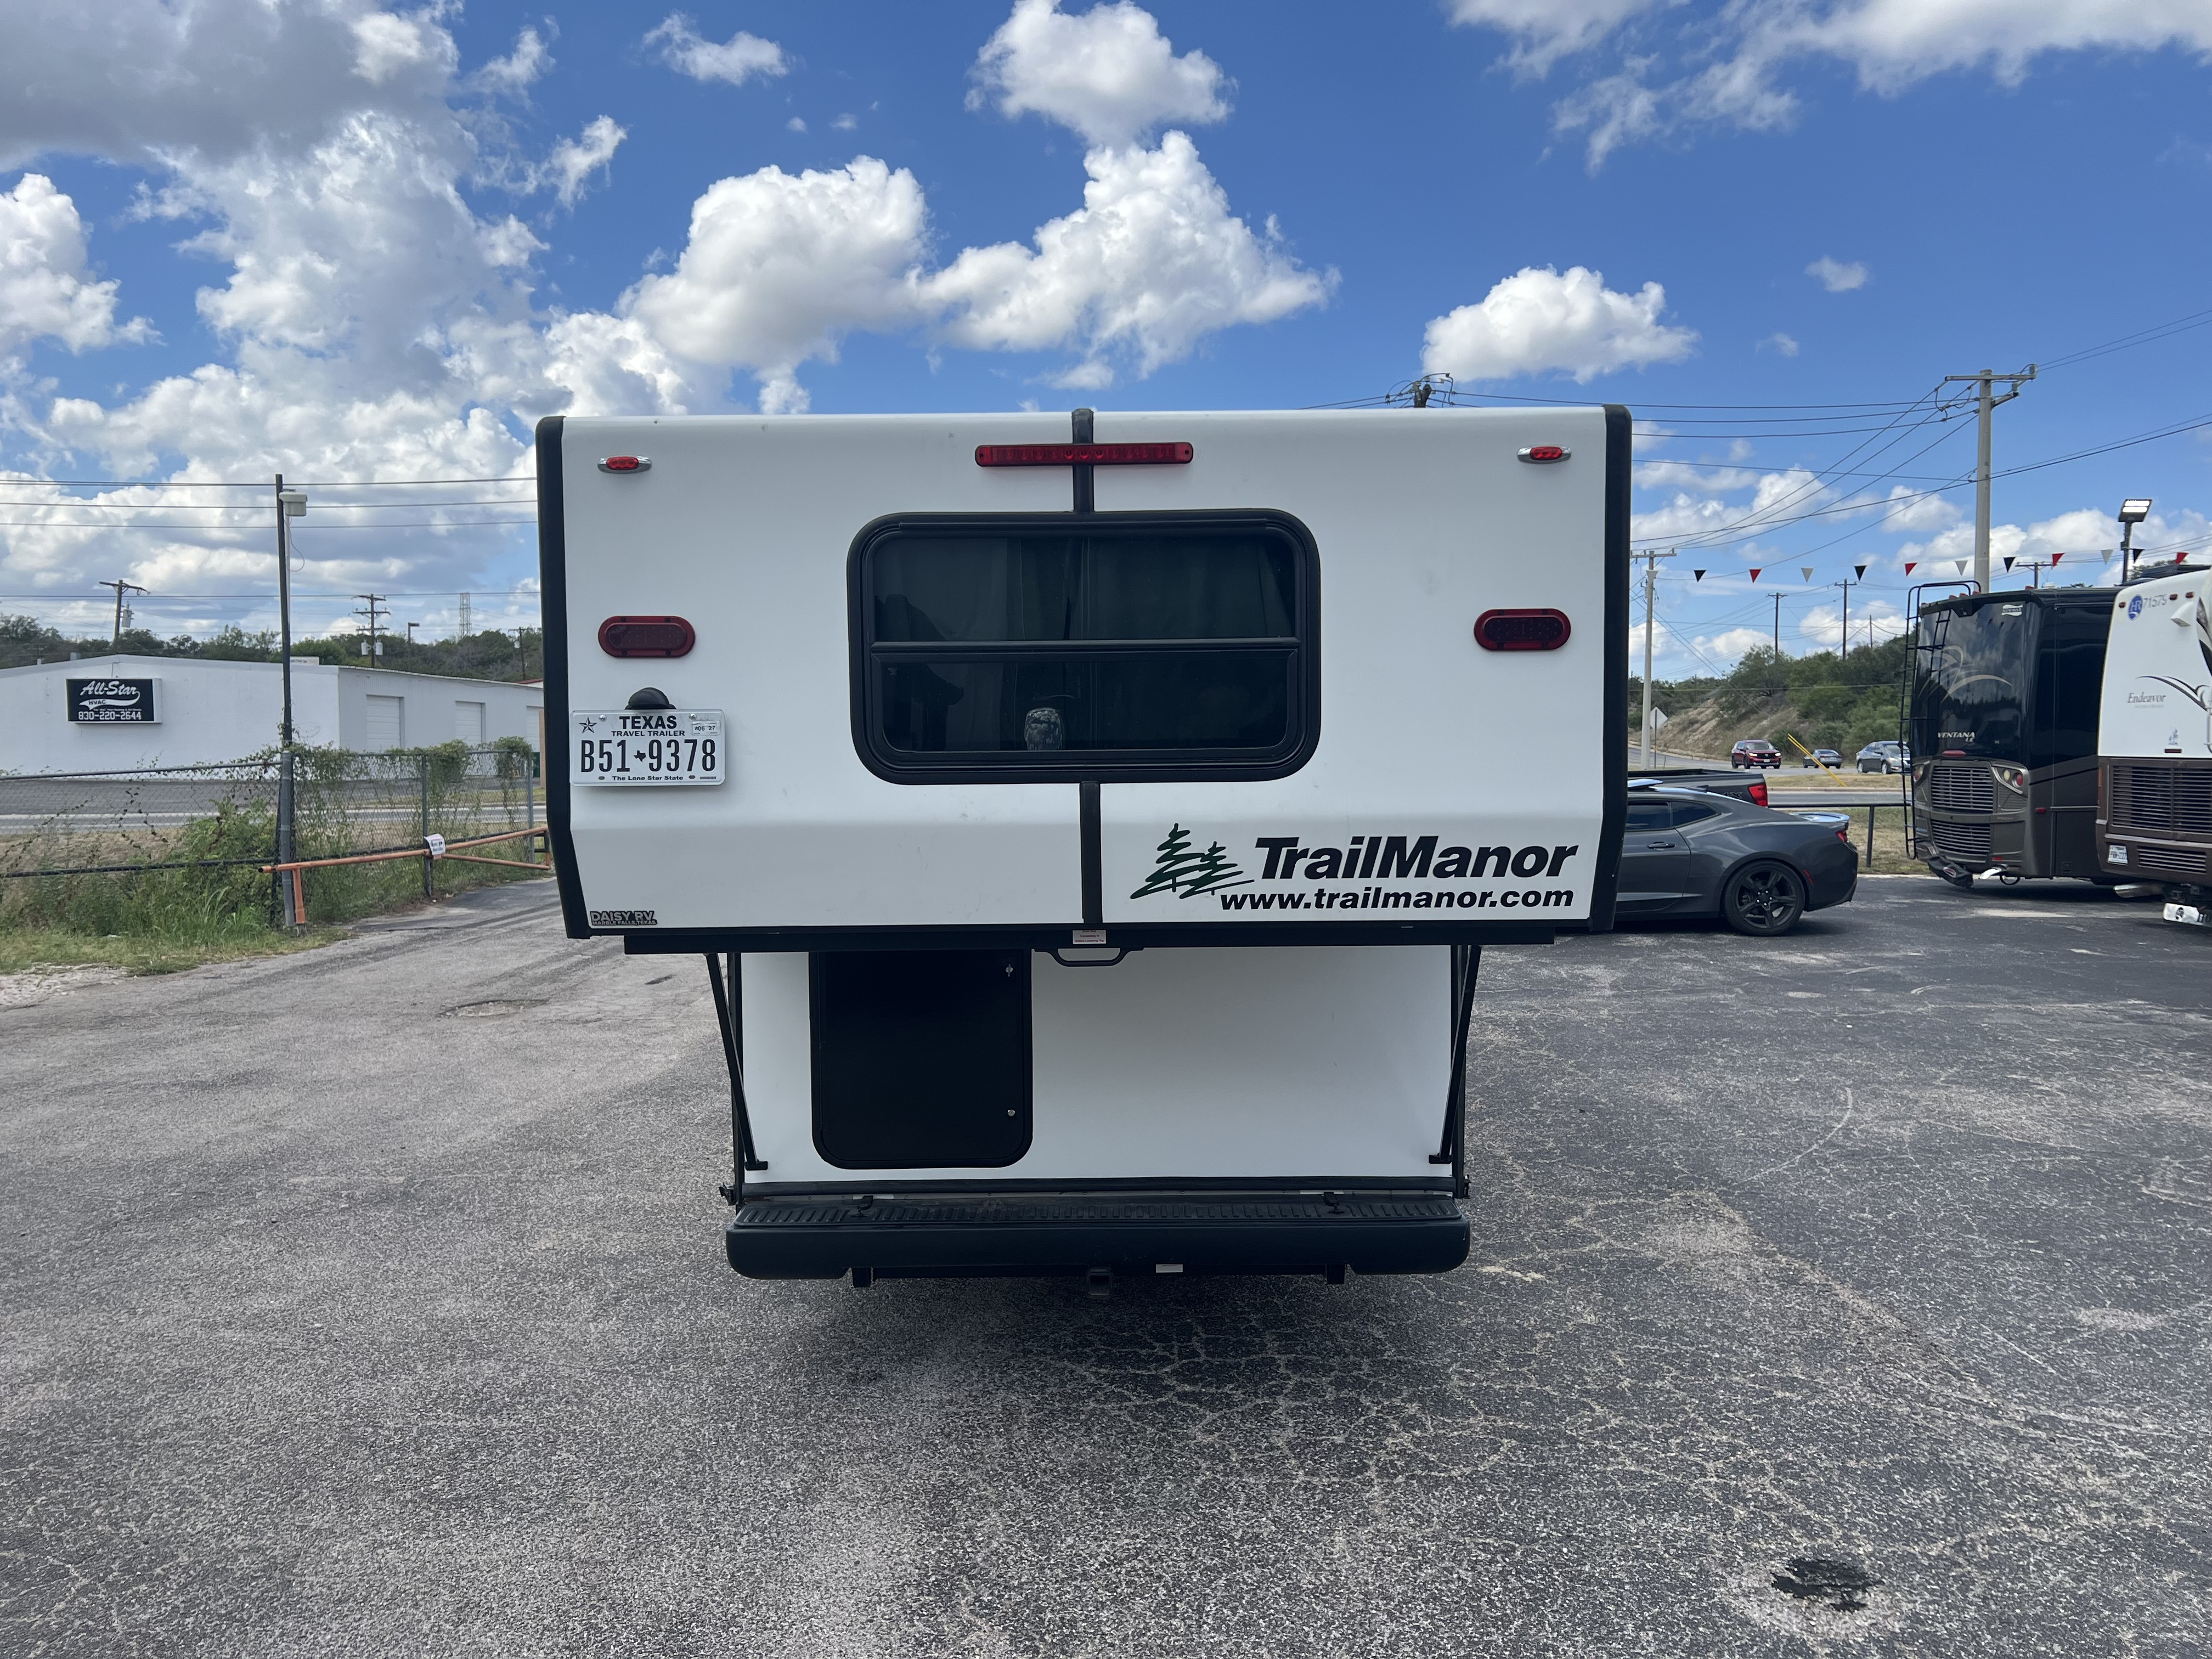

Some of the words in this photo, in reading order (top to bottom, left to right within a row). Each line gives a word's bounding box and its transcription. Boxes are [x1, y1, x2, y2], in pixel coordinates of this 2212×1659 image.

[2142, 594, 2167, 609] 71575
[80, 680, 140, 696] All-Star
[2128, 692, 2166, 703] Endeavor
[78, 711, 142, 720] 830-220-2644
[619, 715, 678, 730] TEXAS
[580, 740, 630, 772] B51
[648, 738, 715, 772] 9378
[1255, 835, 1579, 880] TrailManor
[1220, 886, 1574, 911] www.trailmanor.com
[590, 911, 631, 921] DAISY
